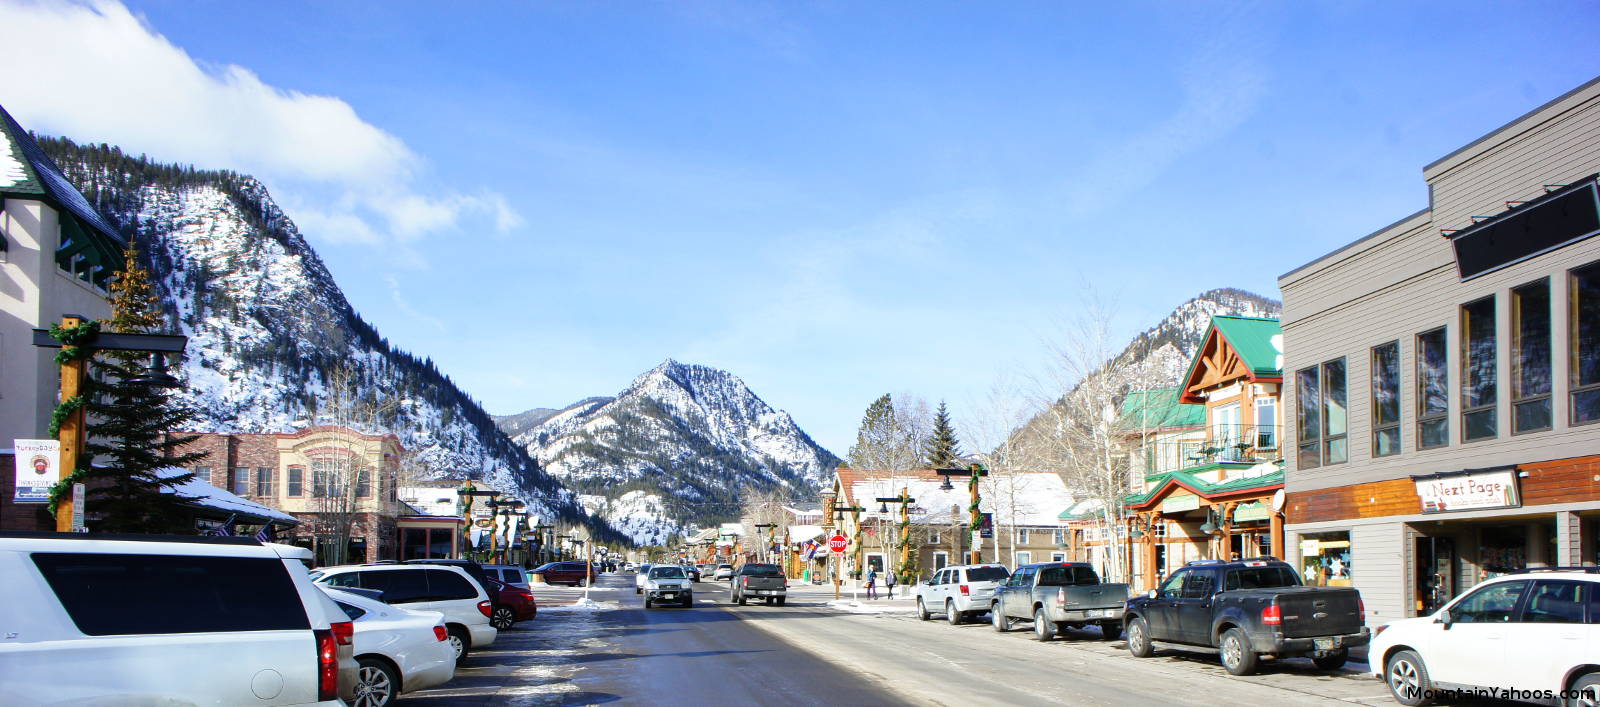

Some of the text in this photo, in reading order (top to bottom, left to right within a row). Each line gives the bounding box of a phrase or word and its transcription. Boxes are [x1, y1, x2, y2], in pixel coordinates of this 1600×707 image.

[1432, 482, 1464, 497] Next
[1468, 479, 1501, 497] Page
[830, 540, 846, 548] STOP
